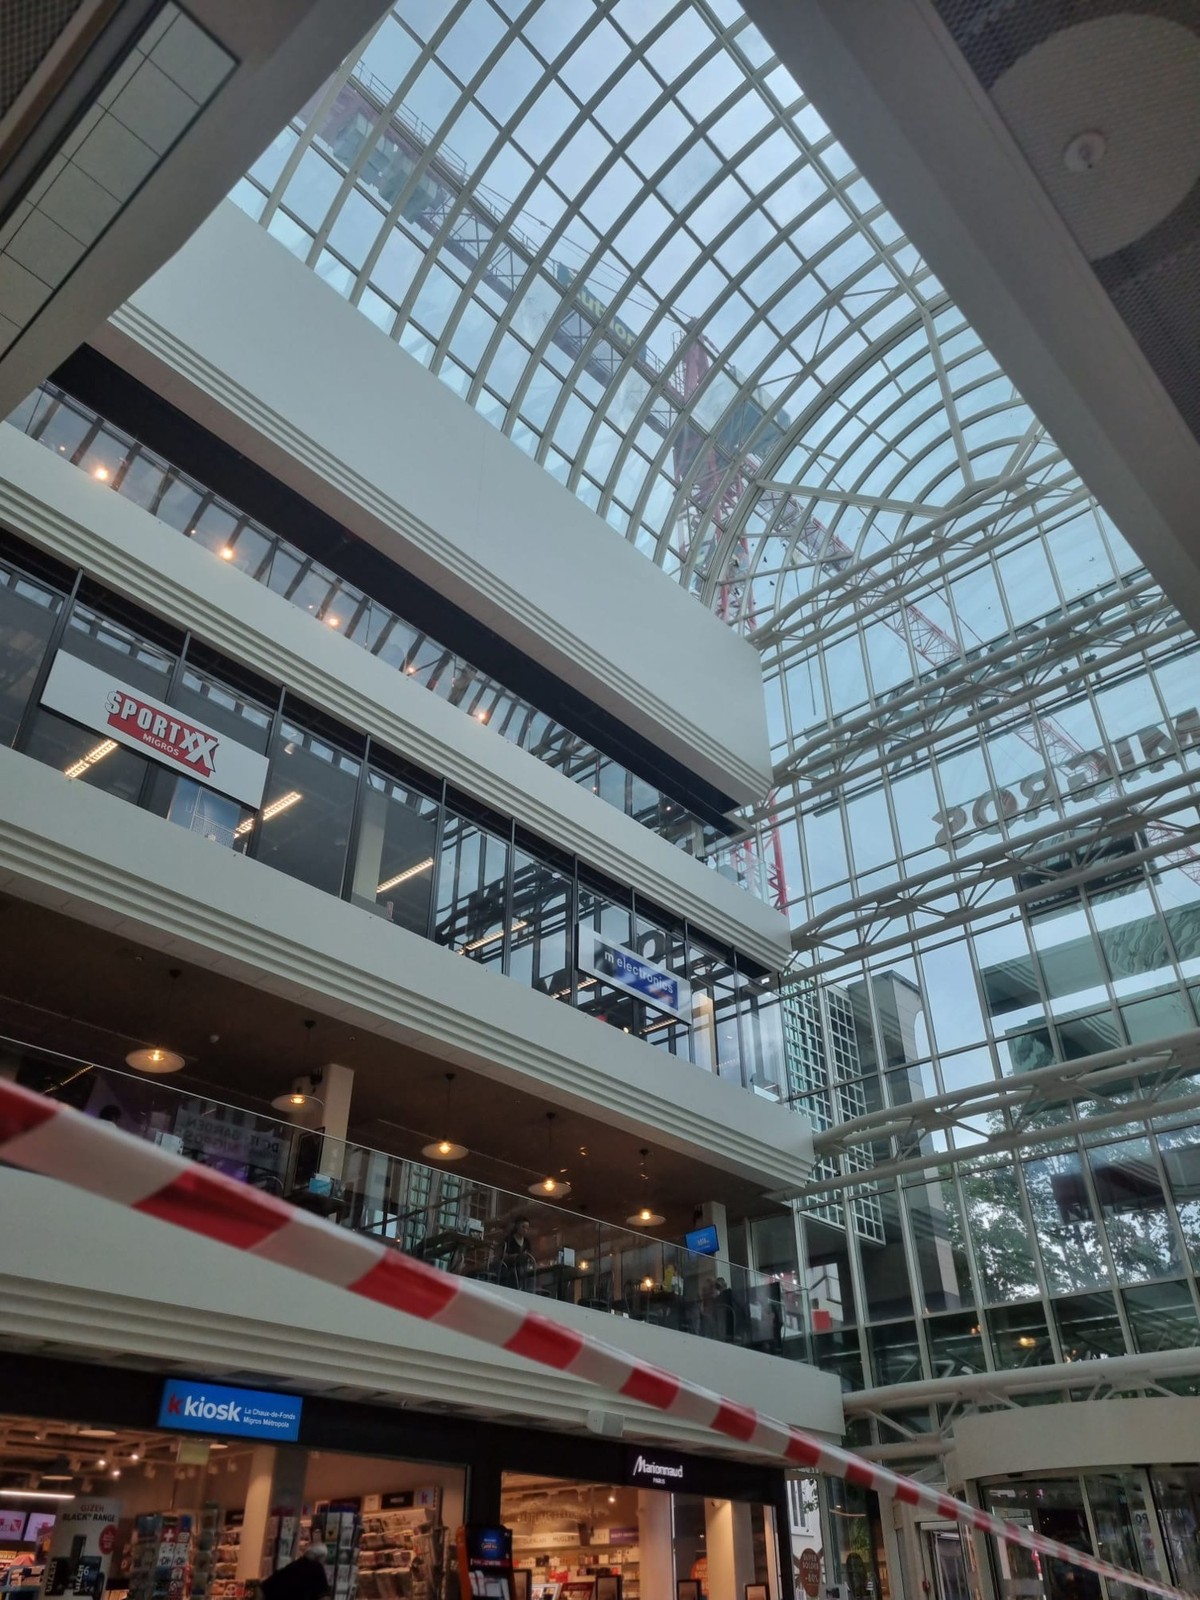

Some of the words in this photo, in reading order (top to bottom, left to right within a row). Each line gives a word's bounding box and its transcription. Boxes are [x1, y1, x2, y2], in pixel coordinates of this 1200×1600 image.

[105, 691, 219, 773] SPORTXX
[143, 733, 180, 756] MIGROS
[616, 957, 674, 994] electronics
[184, 1395, 242, 1423] kiosk
[243, 1416, 262, 1425] Migros
[252, 1408, 296, 1420] Chaux-de-Fonds
[632, 1455, 683, 1478] Marionnaud
[93, 1514, 115, 1522] RANGE
